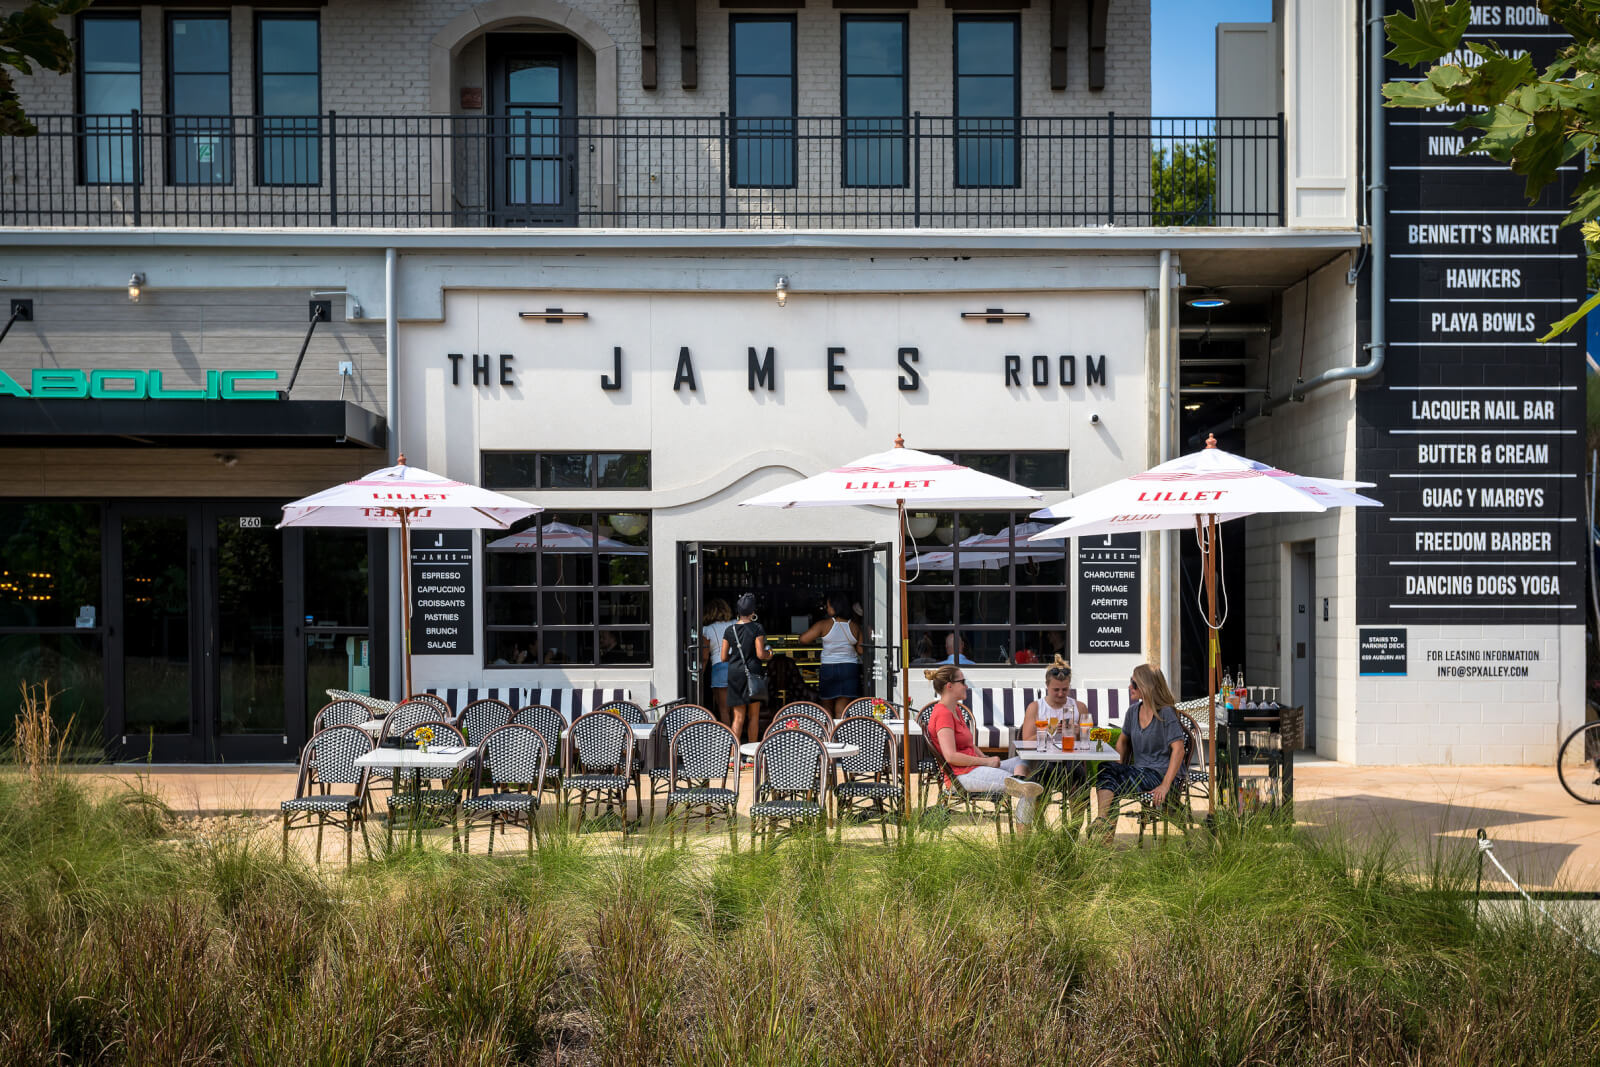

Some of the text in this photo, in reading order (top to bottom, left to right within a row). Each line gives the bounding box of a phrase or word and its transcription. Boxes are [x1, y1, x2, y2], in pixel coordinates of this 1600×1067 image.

[1505, 6, 1549, 25] ROOM
[1428, 136, 1465, 156] NINA
[1408, 225, 1559, 244] BENNETT'S MARKET
[1447, 269, 1521, 288] HAWKERS
[1431, 313, 1535, 332] PLAYA BOWLS
[448, 346, 1106, 392] THE JAMES ROOM
[1412, 401, 1554, 421] LACQUER NAIL BAR
[1418, 444, 1549, 464] BUTTER & CREAM
[844, 480, 936, 489] LILLET
[1137, 491, 1228, 501] LILLET
[1423, 488, 1544, 508] GUAC Y MARGYS
[241, 518, 260, 527] 260
[434, 533, 443, 547] J
[1103, 534, 1112, 546] J
[1415, 532, 1552, 551] FREEDOM BARBER
[421, 572, 461, 580] ESPRESSO
[1084, 571, 1135, 579] CHARCUTERIE
[1406, 575, 1560, 595] DANCING DOGS YOGA
[424, 613, 460, 621] PASTRIES
[1089, 640, 1130, 648] COCKTAILS
[1427, 651, 1540, 661] FOR LEASING INFORMATION
[1437, 666, 1529, 678] INFO@SPXALLEY.COM
